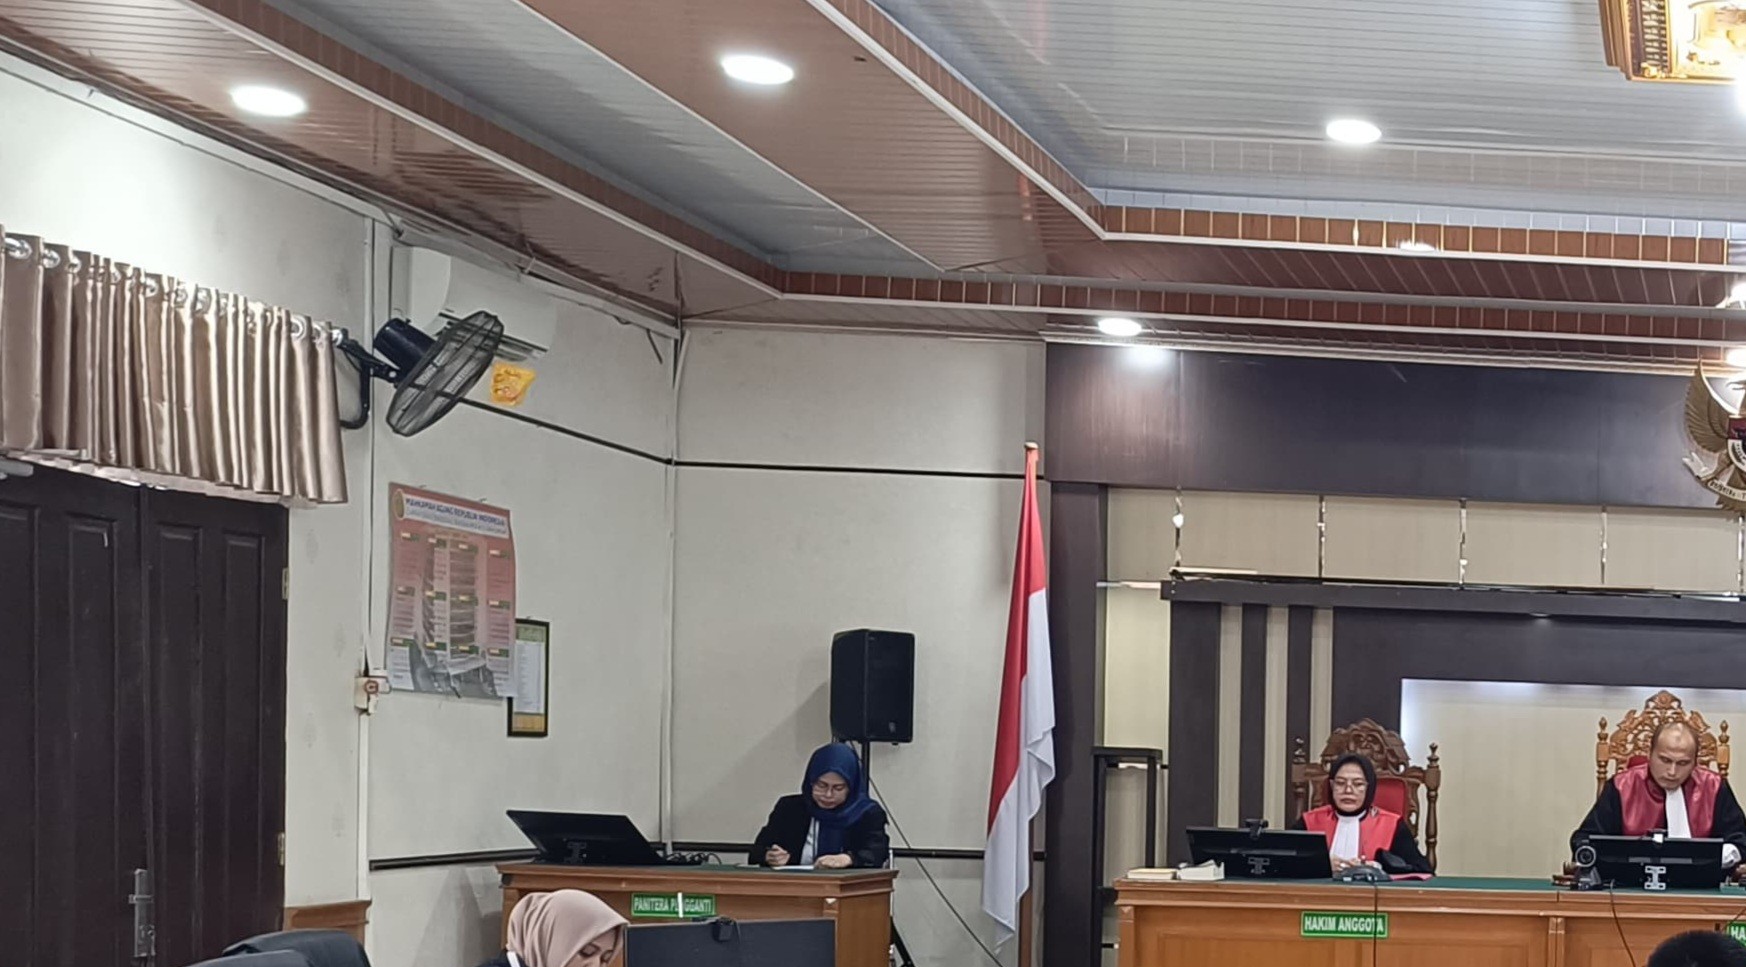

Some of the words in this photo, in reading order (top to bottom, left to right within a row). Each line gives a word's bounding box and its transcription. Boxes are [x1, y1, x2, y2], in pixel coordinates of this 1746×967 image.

[634, 897, 669, 911] PANITERA
[1304, 916, 1337, 931] HAKIM
[1337, 917, 1384, 932] ANGGOTA
